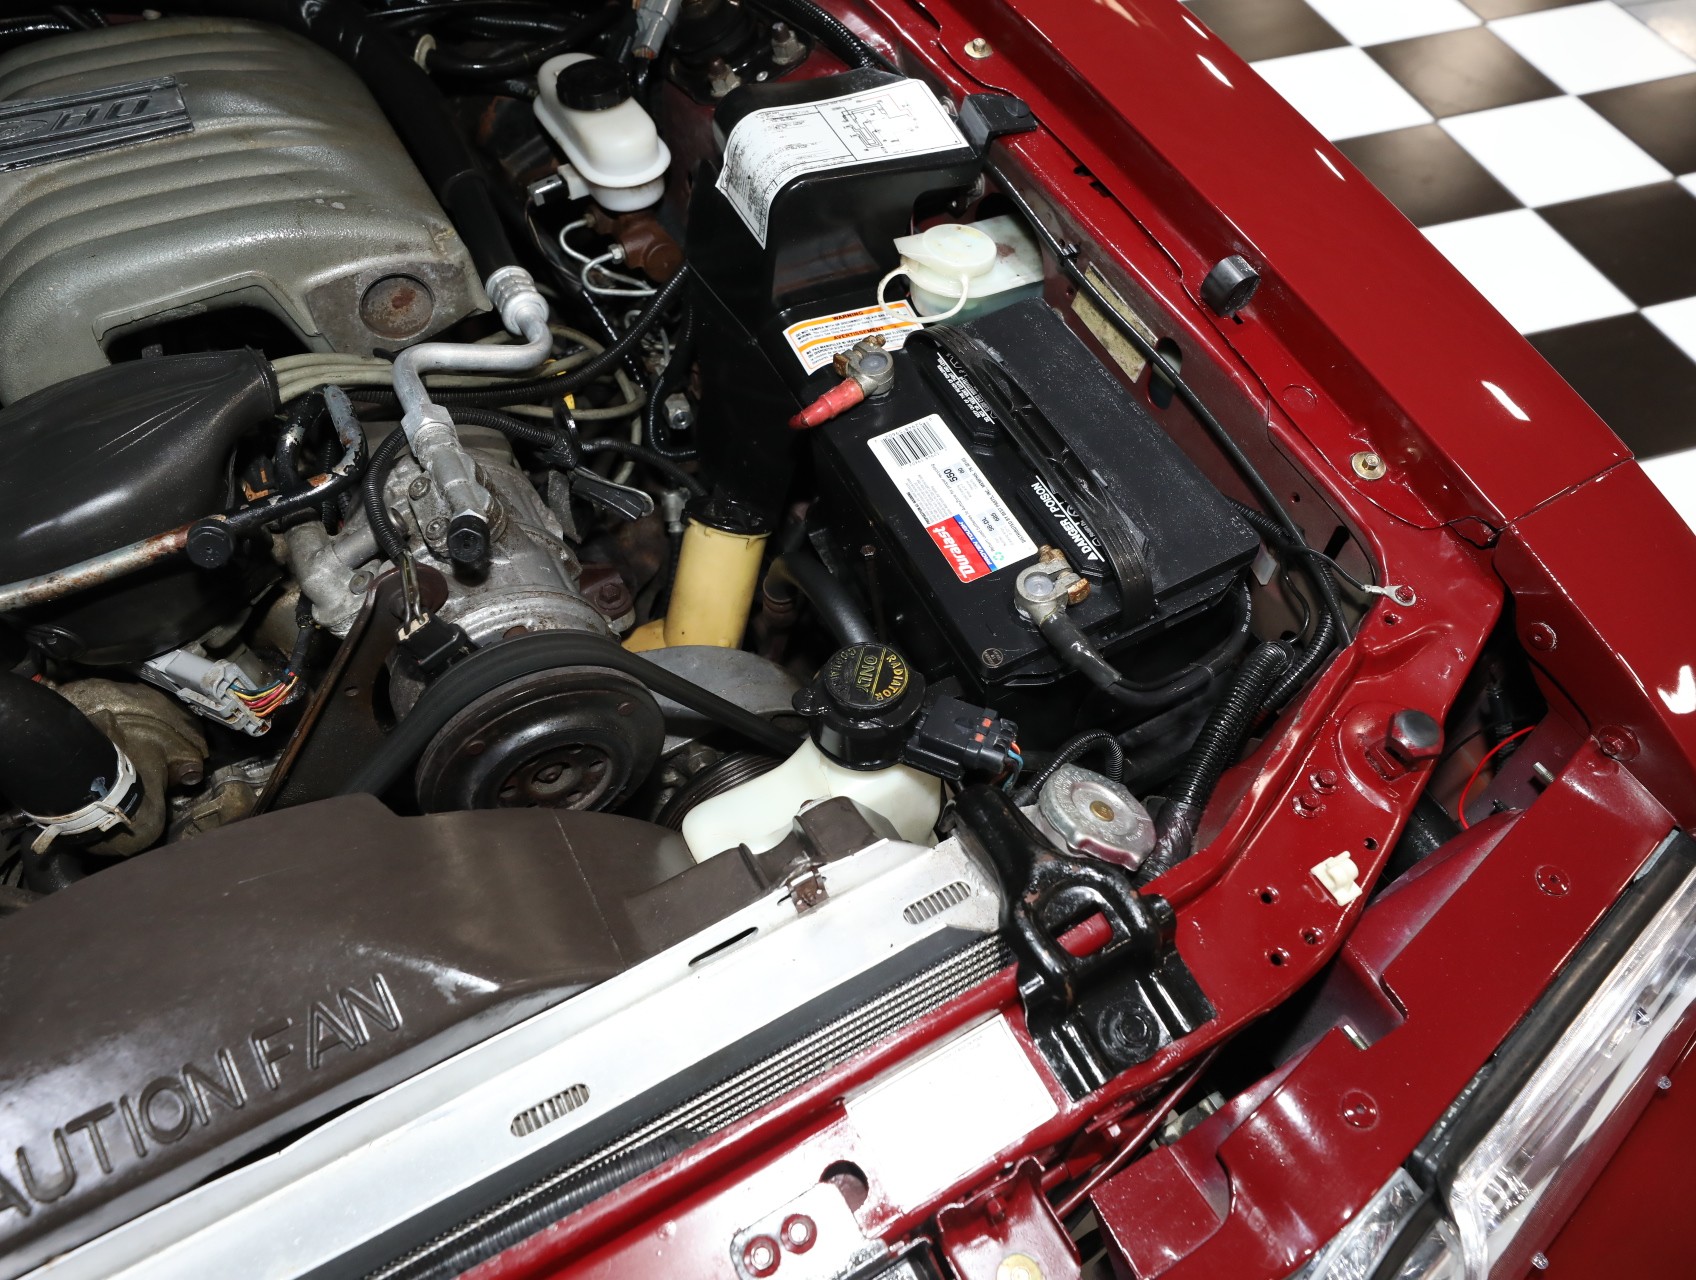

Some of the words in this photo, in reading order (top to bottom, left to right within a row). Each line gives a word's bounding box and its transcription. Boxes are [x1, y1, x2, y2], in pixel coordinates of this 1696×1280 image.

[832, 311, 864, 321] WARNING
[834, 326, 884, 339] AVERTISSEMENT
[941, 467, 958, 483] 550
[1031, 482, 1060, 513] POISON
[958, 520, 975, 540] TOUGH
[1060, 519, 1092, 554] DANGER
[930, 524, 977, 578] Duralast
[972, 540, 993, 565] PROVEN
[856, 655, 878, 693] ONLY
[874, 653, 904, 701] RADIATOR
[249, 972, 403, 1090] FAN
